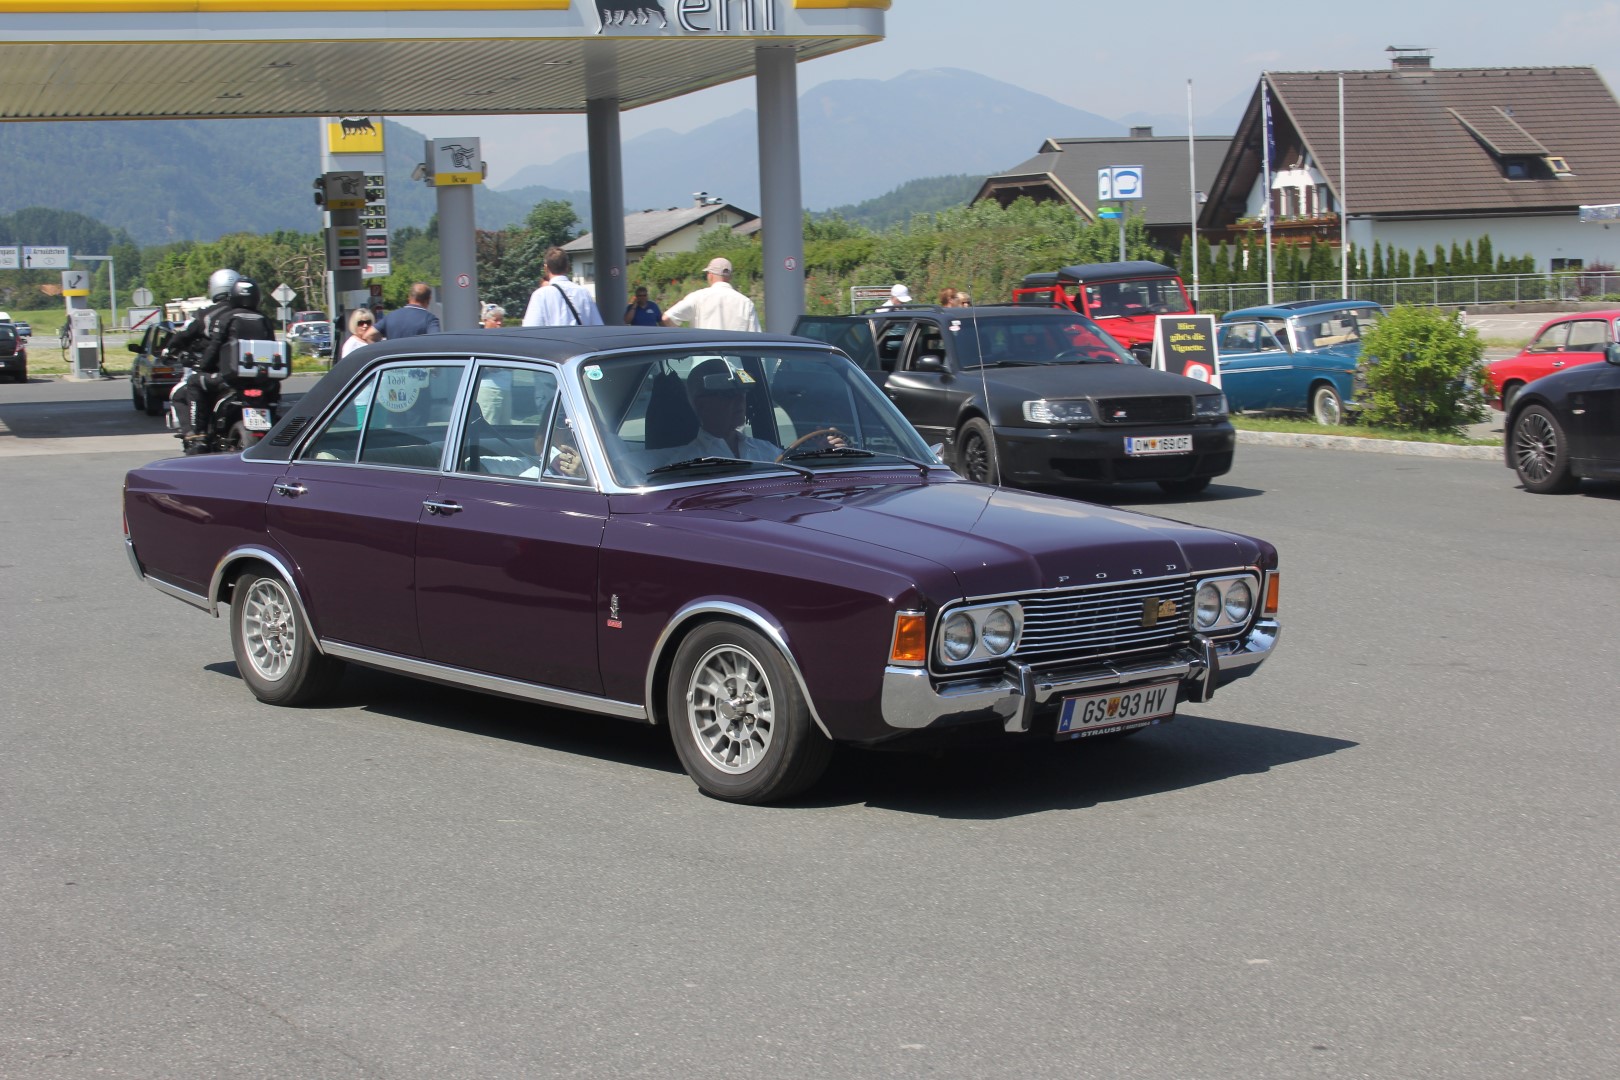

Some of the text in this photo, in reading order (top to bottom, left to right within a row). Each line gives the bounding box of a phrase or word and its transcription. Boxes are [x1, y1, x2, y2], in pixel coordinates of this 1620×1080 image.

[1177, 322, 1196, 330] Hier
[1169, 332, 1206, 343] gibt's die
[1171, 344, 1206, 353] Vignette.
[1082, 698, 1108, 724] GS
[1118, 693, 1142, 718] 93
[1143, 687, 1168, 714] HV
[1080, 725, 1122, 738] STRAUSS
